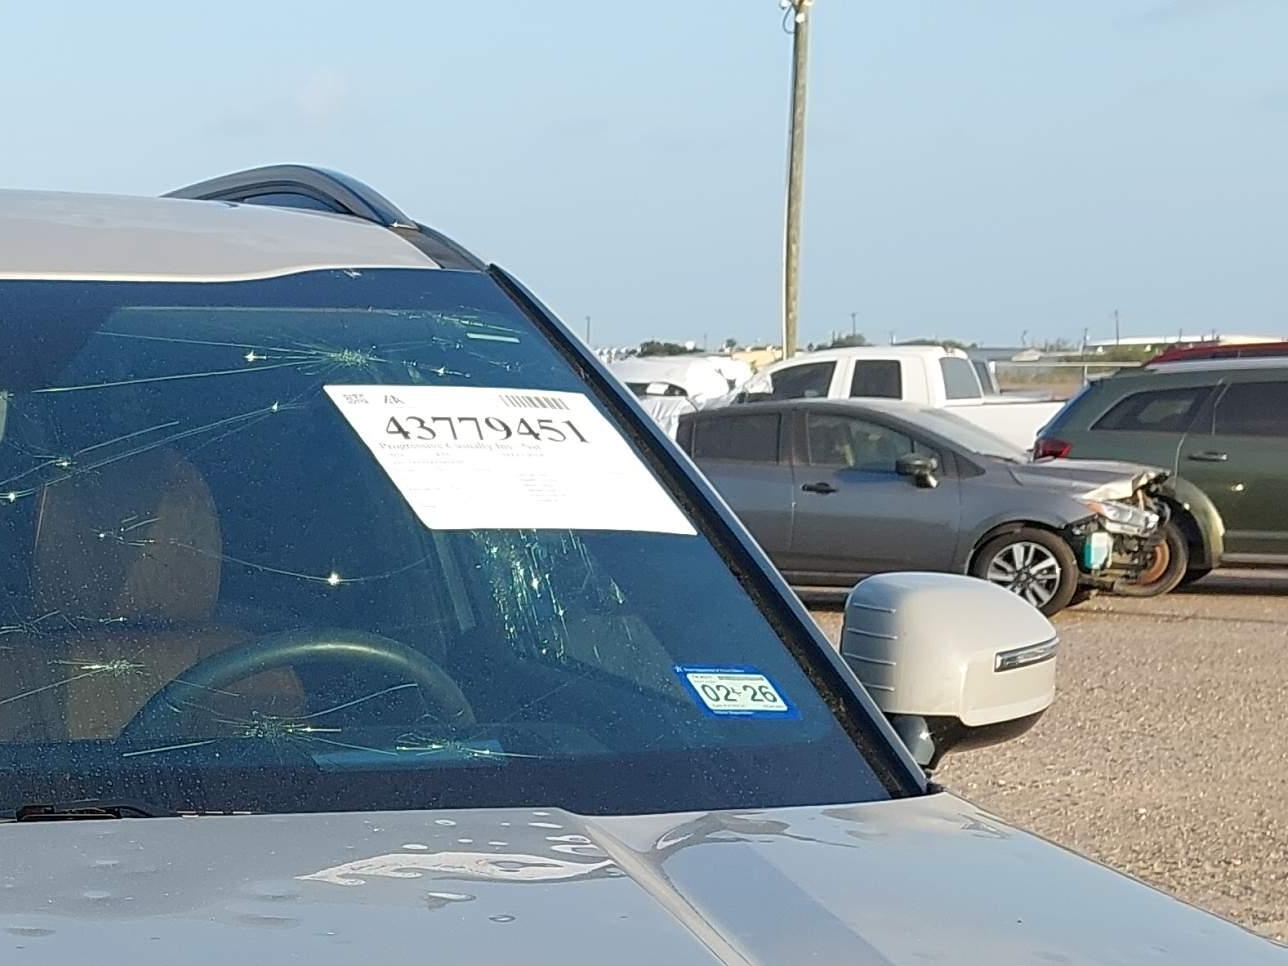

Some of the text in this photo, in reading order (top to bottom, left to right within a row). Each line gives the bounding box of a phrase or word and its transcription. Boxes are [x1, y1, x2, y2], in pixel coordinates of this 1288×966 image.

[385, 416, 591, 443] 43779451
[701, 684, 778, 703] 02 26
